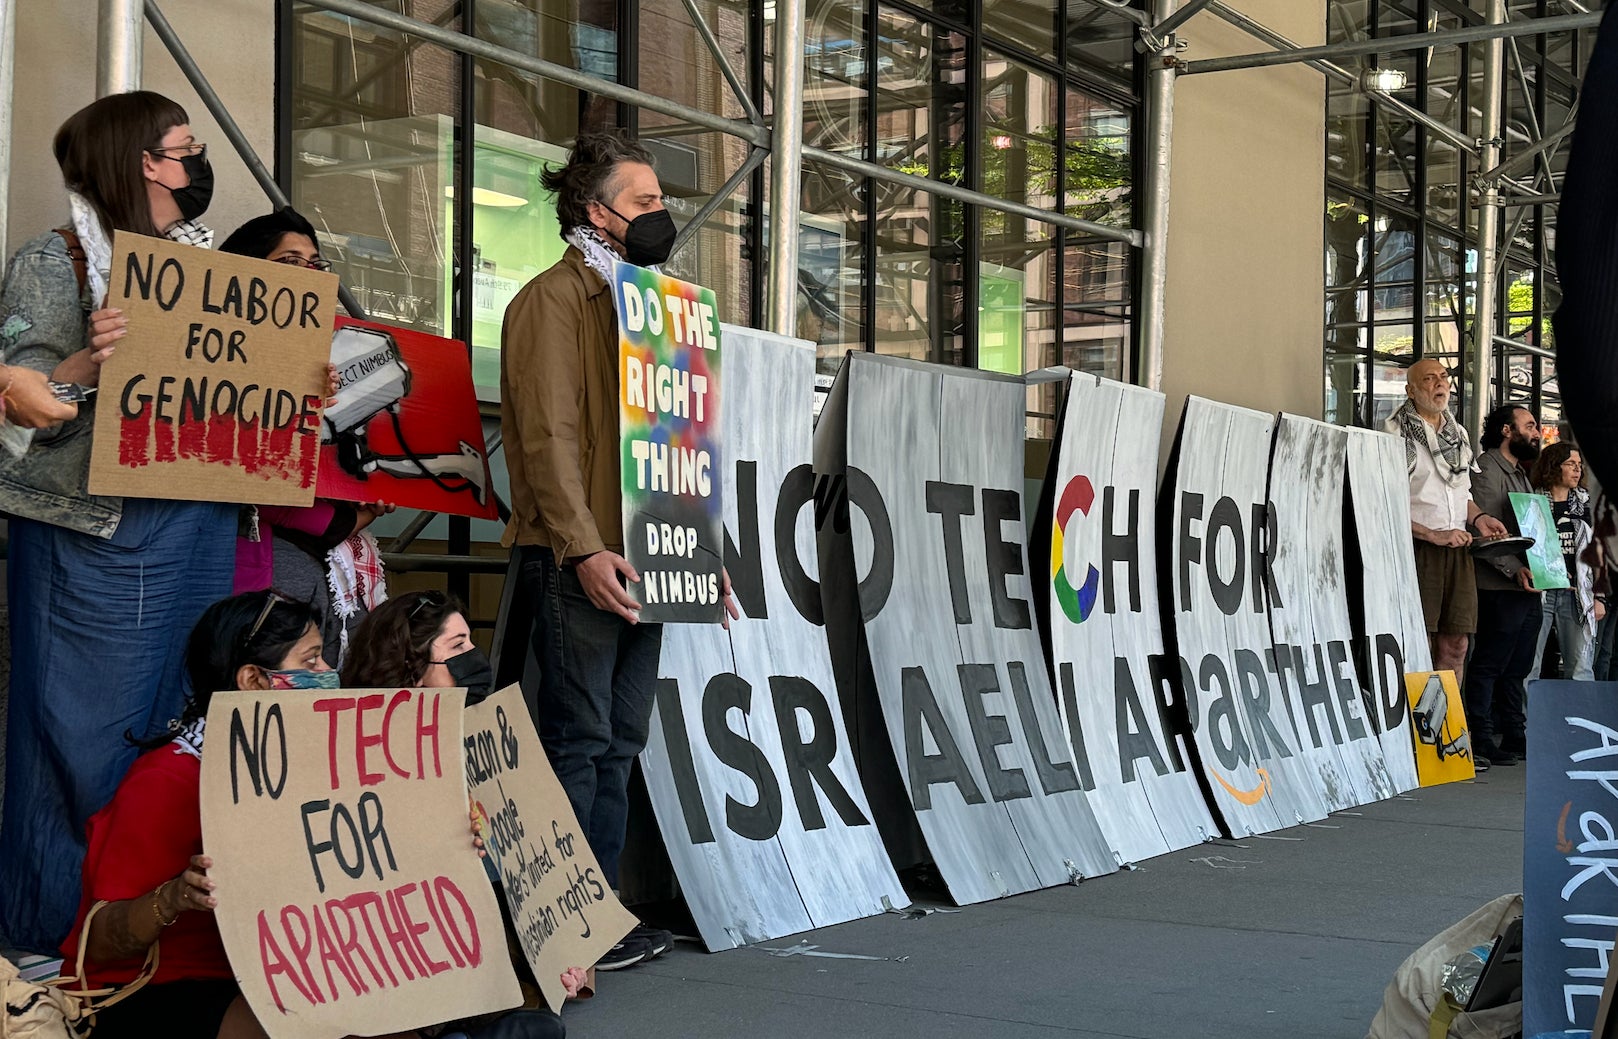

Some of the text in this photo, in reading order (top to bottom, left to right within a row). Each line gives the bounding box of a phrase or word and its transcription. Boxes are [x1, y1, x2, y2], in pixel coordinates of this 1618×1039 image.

[124, 251, 322, 330] NO LABOR
[622, 281, 718, 351] DO THE
[186, 324, 247, 364] FOR
[336, 348, 395, 390] JECT NIMBUS
[120, 374, 320, 435] GENOCIDE
[626, 356, 708, 423] RIGHT
[631, 439, 711, 498] THING
[646, 522, 698, 560] DROP
[925, 474, 1141, 630] TECH
[1179, 491, 1284, 616] FOR
[644, 570, 719, 606] NIMBUS
[229, 689, 443, 805] NO TECH
[496, 705, 519, 770] &
[656, 661, 1097, 845] ISRAELI
[300, 791, 399, 893] FOR
[527, 835, 556, 889] united
[551, 820, 575, 861] for
[556, 863, 605, 939] rights
[257, 876, 482, 1016] APARTHEID
